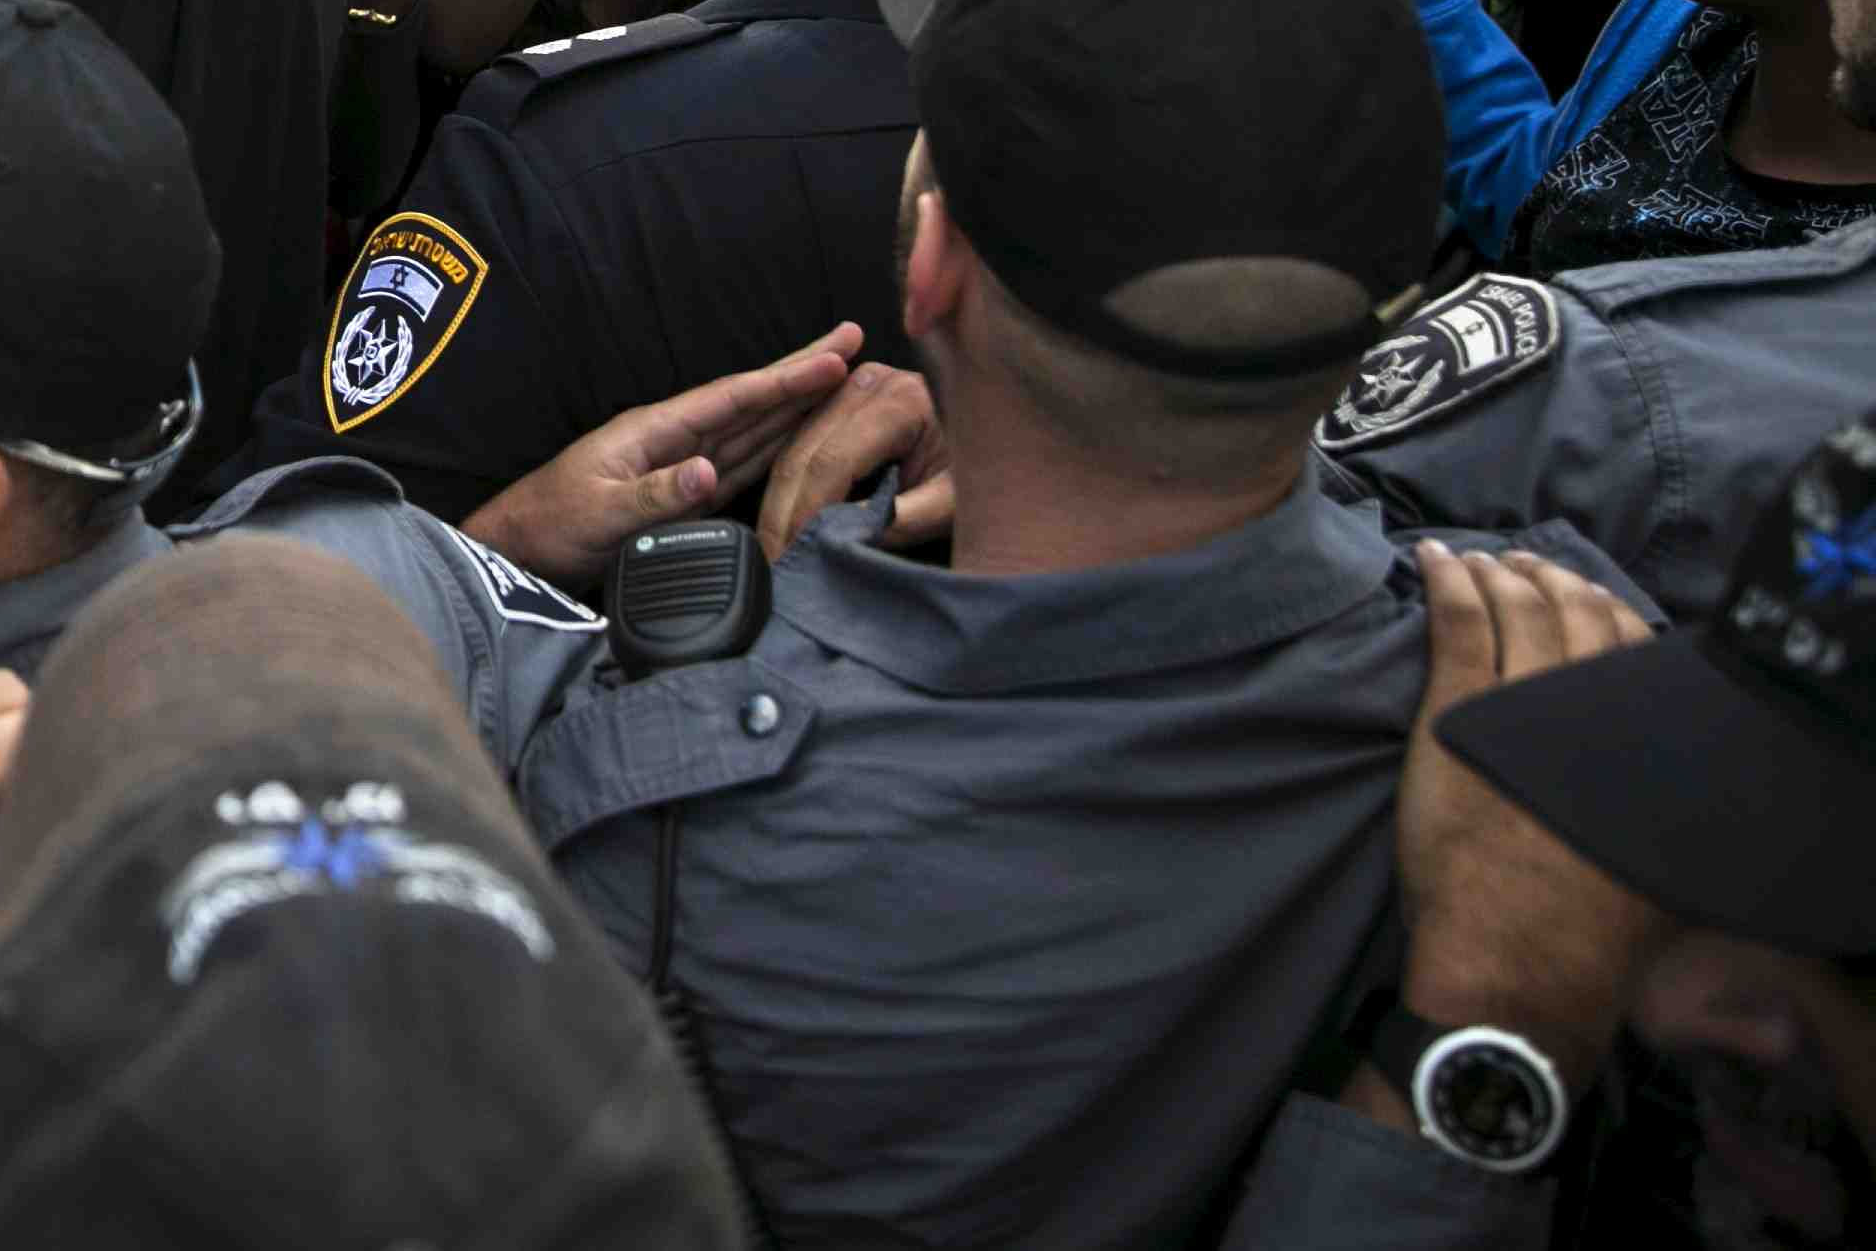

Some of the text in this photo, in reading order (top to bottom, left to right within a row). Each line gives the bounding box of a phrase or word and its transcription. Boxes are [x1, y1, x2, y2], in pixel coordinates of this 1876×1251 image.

[409, 232, 468, 283] משטרת
[1477, 284, 1539, 357] ISRAEL POLICE
[658, 529, 729, 544] MOTOROLA
